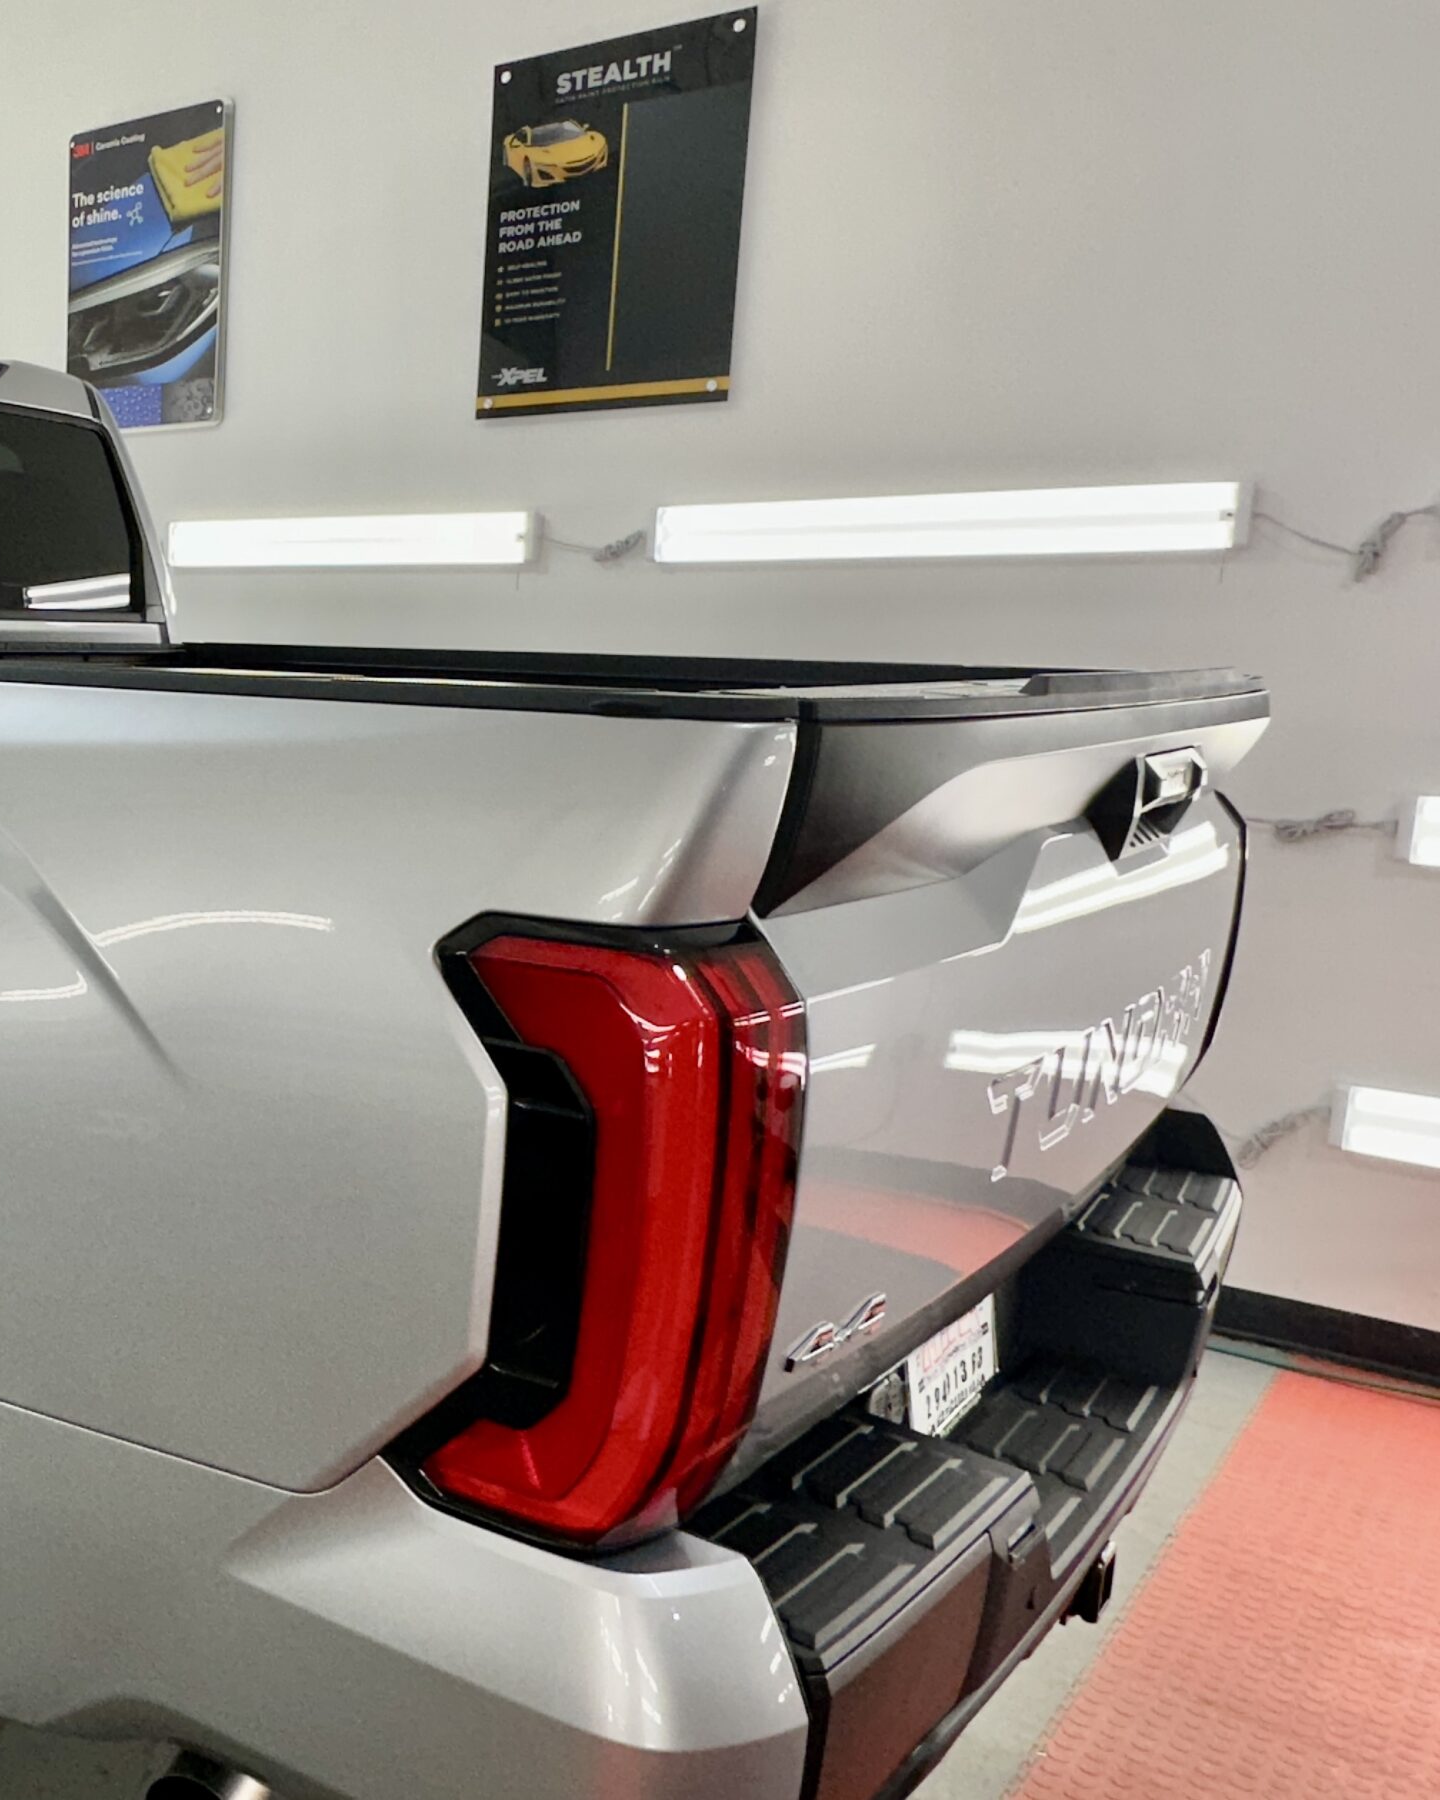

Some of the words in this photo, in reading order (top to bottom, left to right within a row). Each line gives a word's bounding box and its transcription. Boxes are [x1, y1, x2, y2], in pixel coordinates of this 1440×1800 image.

[556, 50, 672, 95] STEALTH
[121, 133, 146, 146] Coating
[72, 192, 96, 209] The
[97, 184, 144, 204] science
[71, 210, 86, 228] of
[86, 208, 122, 226] shine.
[500, 200, 580, 224] PROTECTION
[499, 223, 535, 239] FROM
[537, 218, 563, 233] THE
[498, 238, 536, 254] ROAD
[537, 231, 582, 249] AHEAD
[496, 367, 548, 386] XPEL
